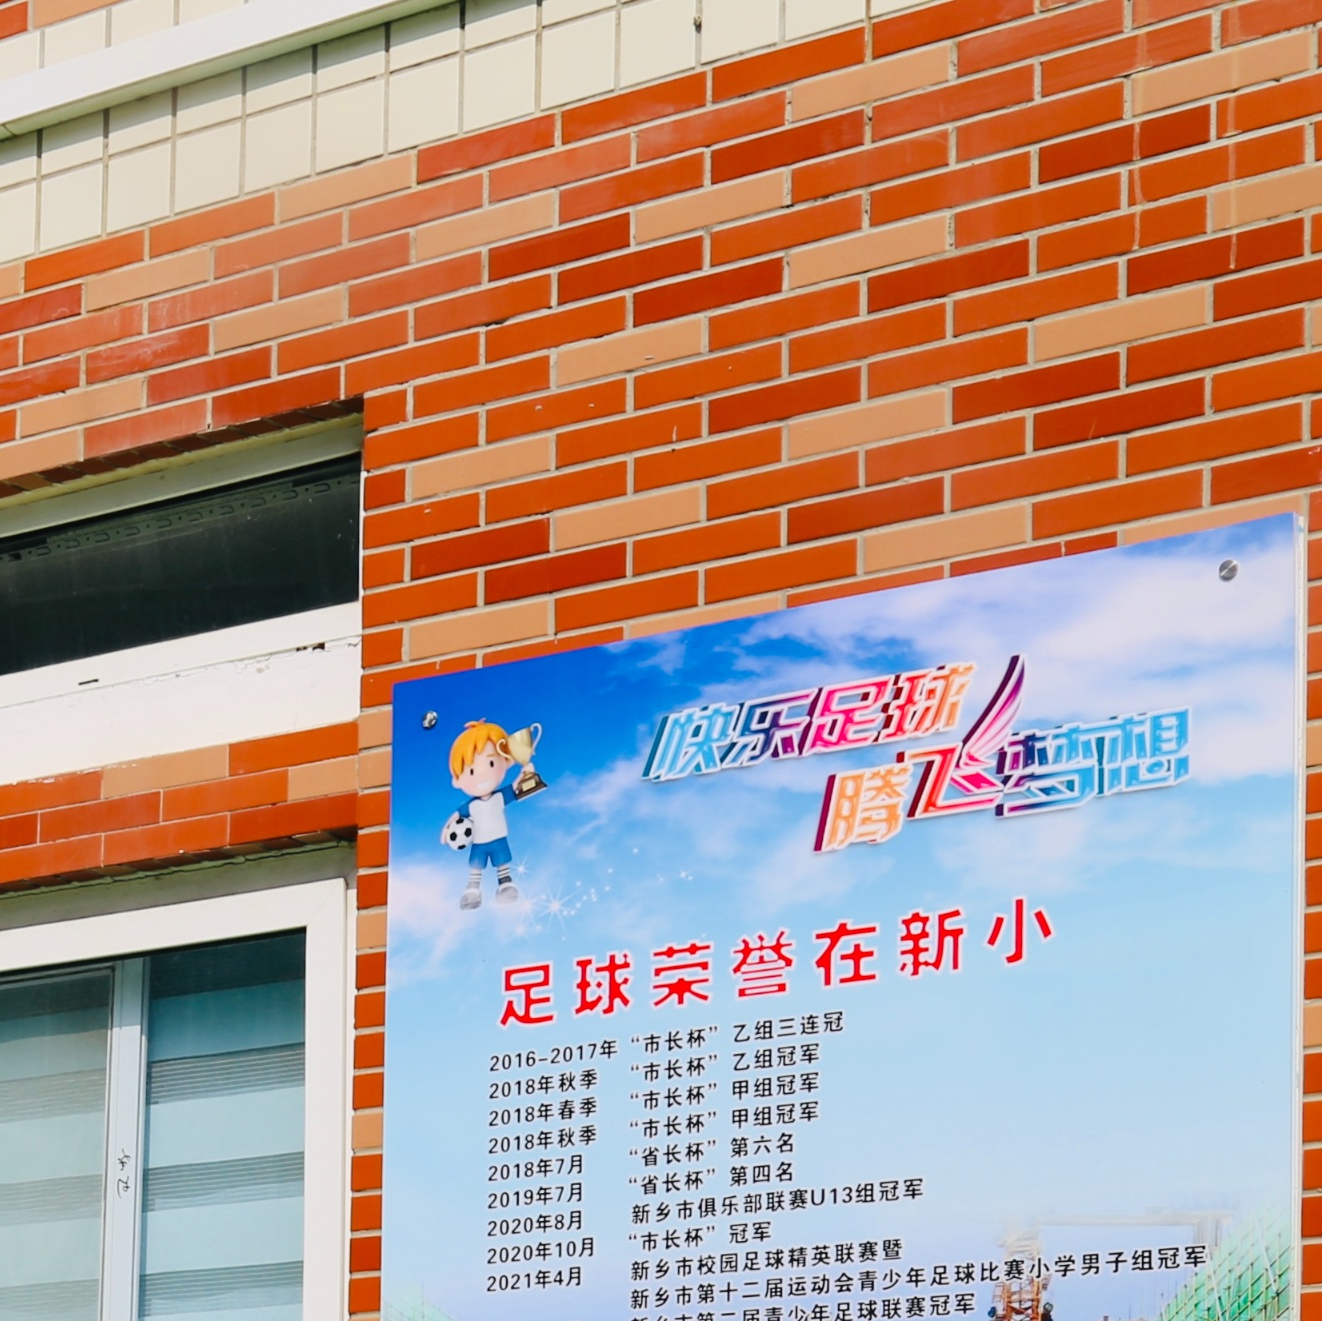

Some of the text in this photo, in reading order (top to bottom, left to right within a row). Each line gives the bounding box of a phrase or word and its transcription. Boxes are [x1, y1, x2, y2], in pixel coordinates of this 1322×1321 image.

[642, 662, 974, 782] 快乐足球
[813, 655, 1193, 854] 腾飞梦想
[499, 897, 1052, 1028] 足球荣誉在新小
[489, 1040, 618, 1071] 2016-2017年
[489, 1069, 598, 1100] 2018年秋季
[488, 1096, 598, 1127] 2018年春季
[488, 1125, 597, 1154] 2018年秋季
[488, 1154, 584, 1182] 2018年7月
[487, 1182, 583, 1209] 2019年7月
[487, 1178, 924, 1237] 2020年8月 新乡市俱乐部联赛U13组冠军
[486, 1239, 903, 1292] 2021年4月 新乡市校园足球精英联赛暨
[487, 1237, 595, 1265] 2020年10月
[630, 1244, 1208, 1311] 新乡市第十二届运动会青少年足球比赛小学男子组冠军
